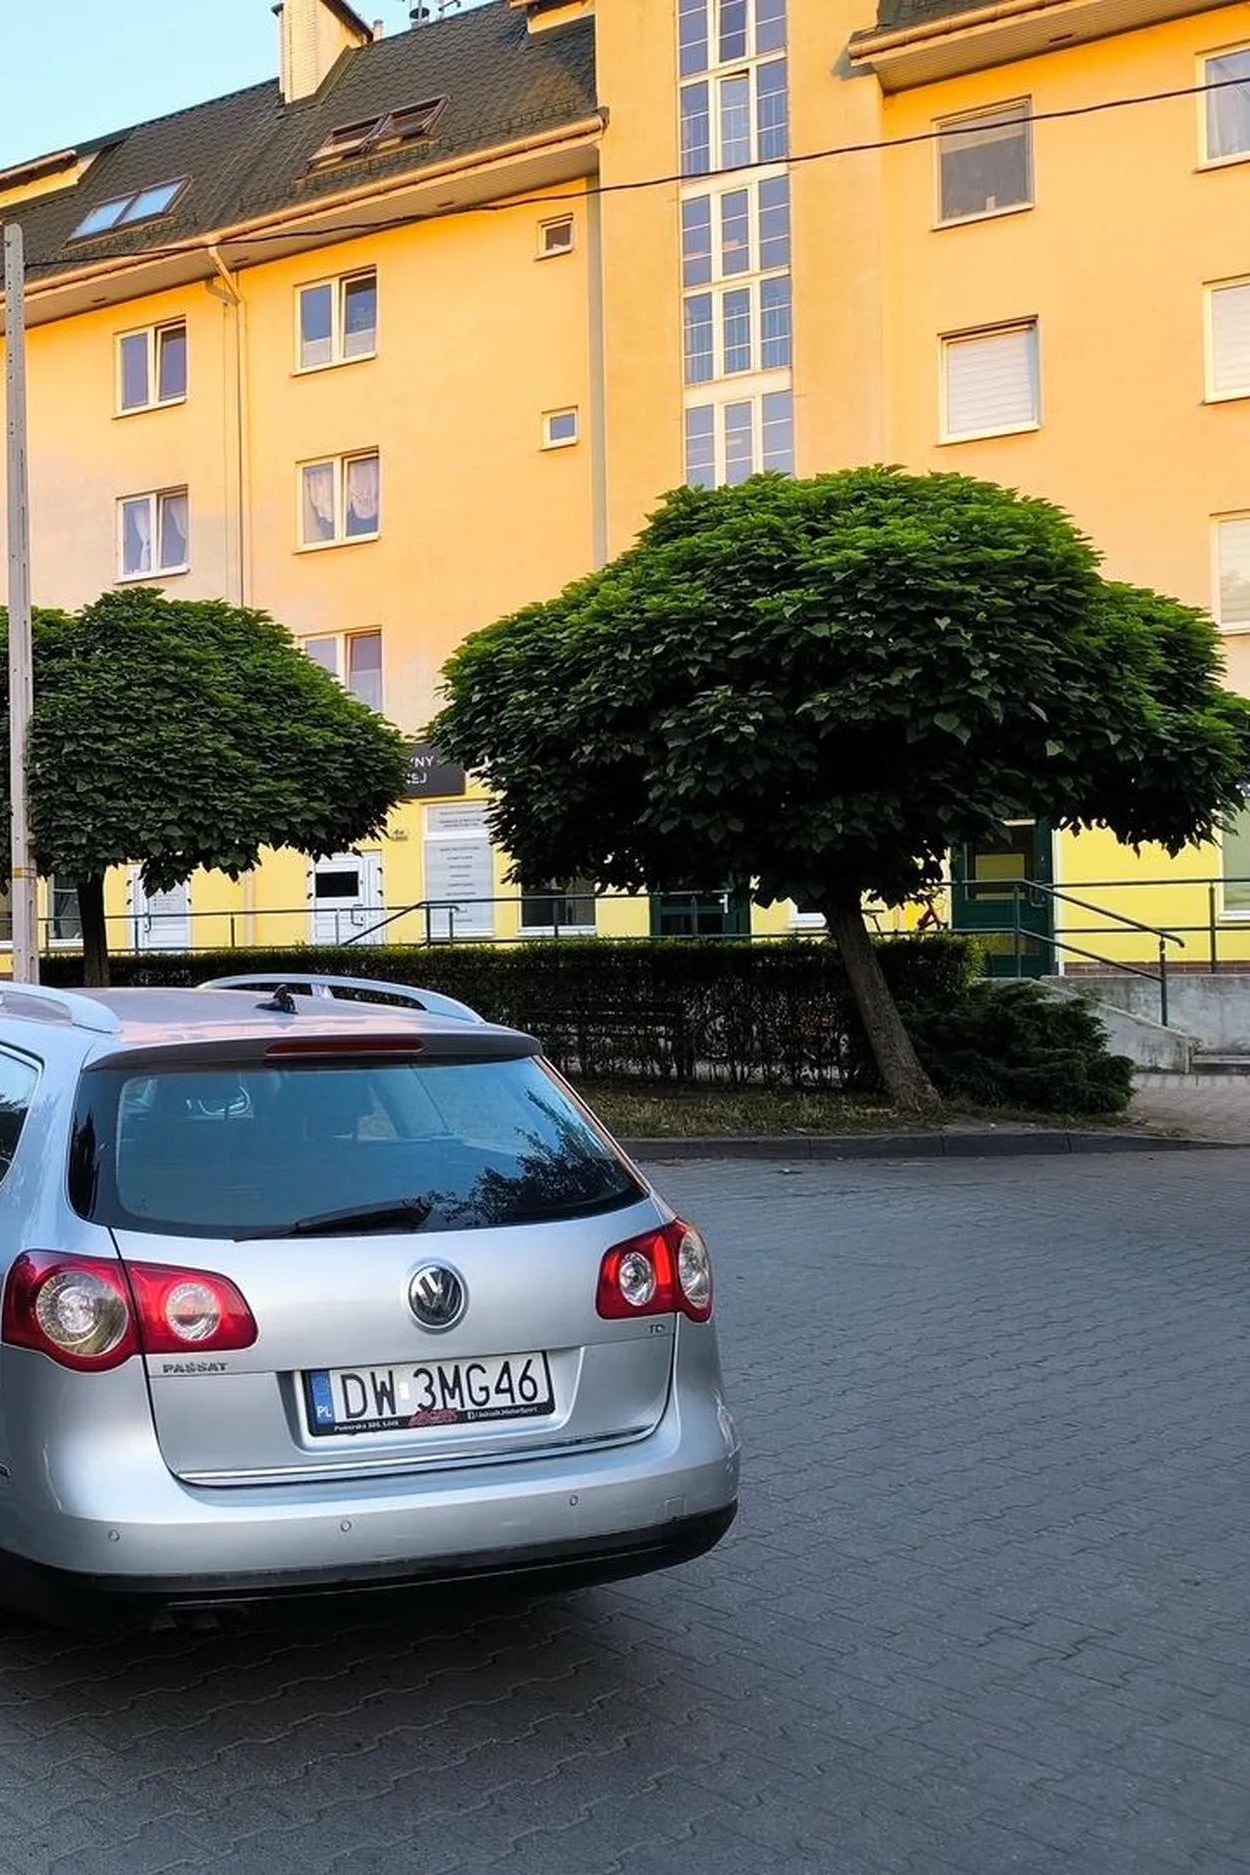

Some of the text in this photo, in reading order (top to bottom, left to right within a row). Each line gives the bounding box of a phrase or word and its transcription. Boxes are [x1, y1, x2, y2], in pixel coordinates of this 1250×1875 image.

[162, 1361, 229, 1374] PASSAT
[340, 1358, 538, 1419] DW 3MG46
[316, 1405, 332, 1417] PL
